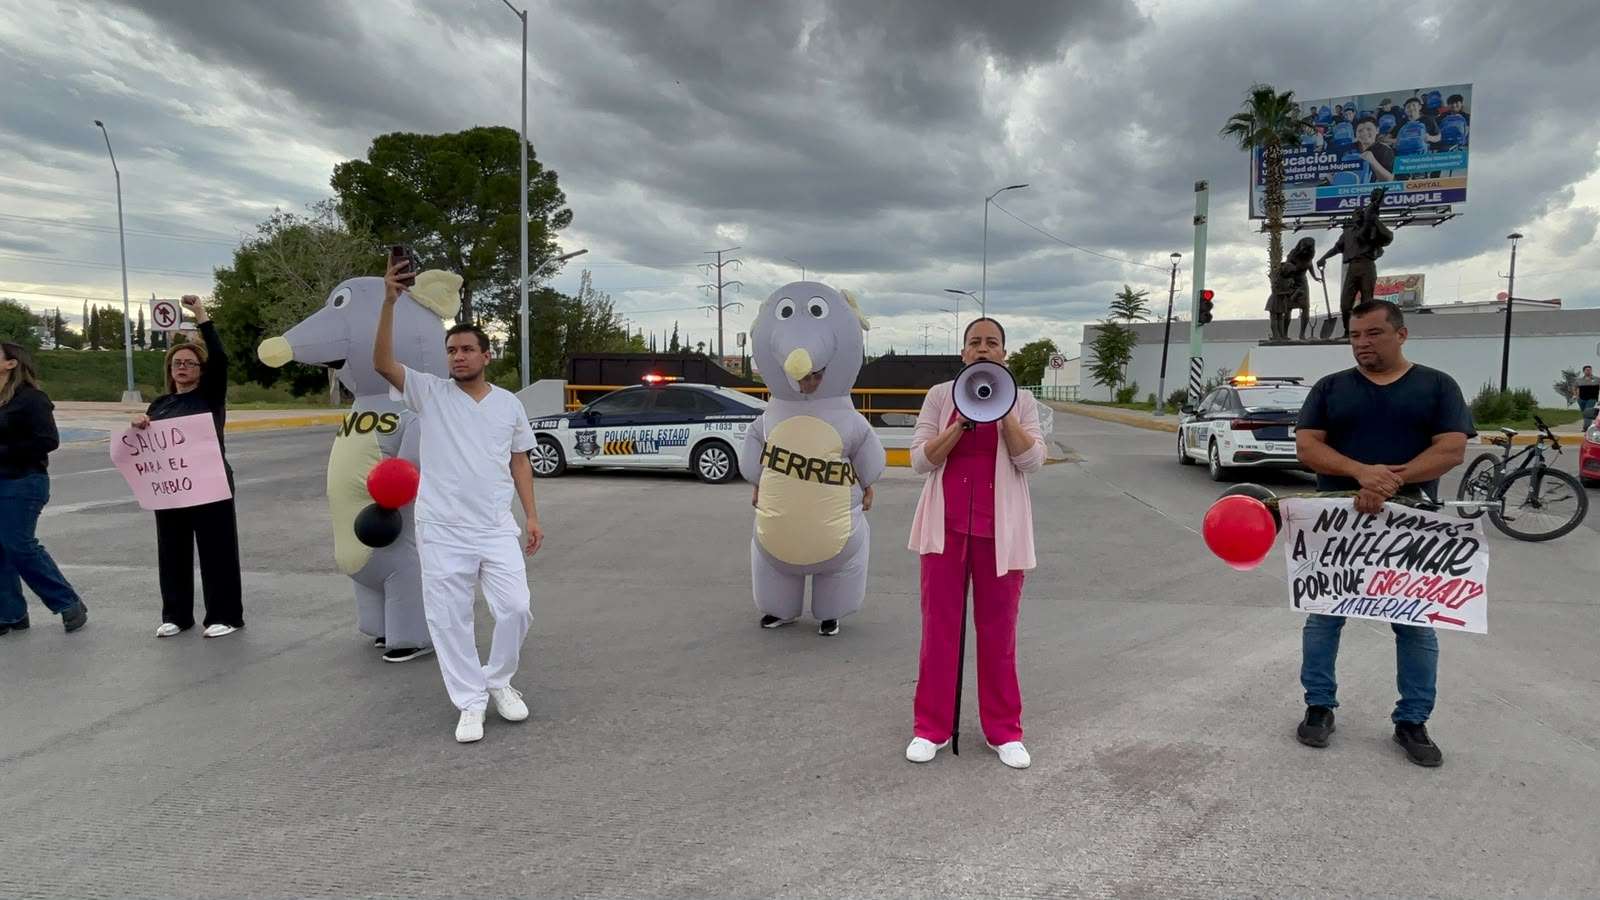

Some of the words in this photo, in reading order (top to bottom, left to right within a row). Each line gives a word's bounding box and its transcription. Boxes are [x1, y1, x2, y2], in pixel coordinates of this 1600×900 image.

[1330, 162, 1360, 171] Mujeres
[1338, 194, 1361, 208] ASÍ
[1384, 192, 1442, 205] CUMPLE
[122, 427, 185, 456] SALUD
[604, 428, 637, 442] POLICÍA
[639, 429, 654, 441] DEL
[658, 427, 690, 440] ESTADO
[636, 440, 659, 453] VIAL
[136, 460, 163, 476] PARA
[168, 458, 188, 471] EL
[151, 477, 192, 496] PUEBLO
[1312, 506, 1349, 533] NO
[1351, 511, 1378, 531] TE
[1292, 529, 1308, 561] A
[1319, 530, 1480, 576] ENFERMAR
[1366, 570, 1412, 597] NO
[1331, 598, 1433, 624] MATERIAL
